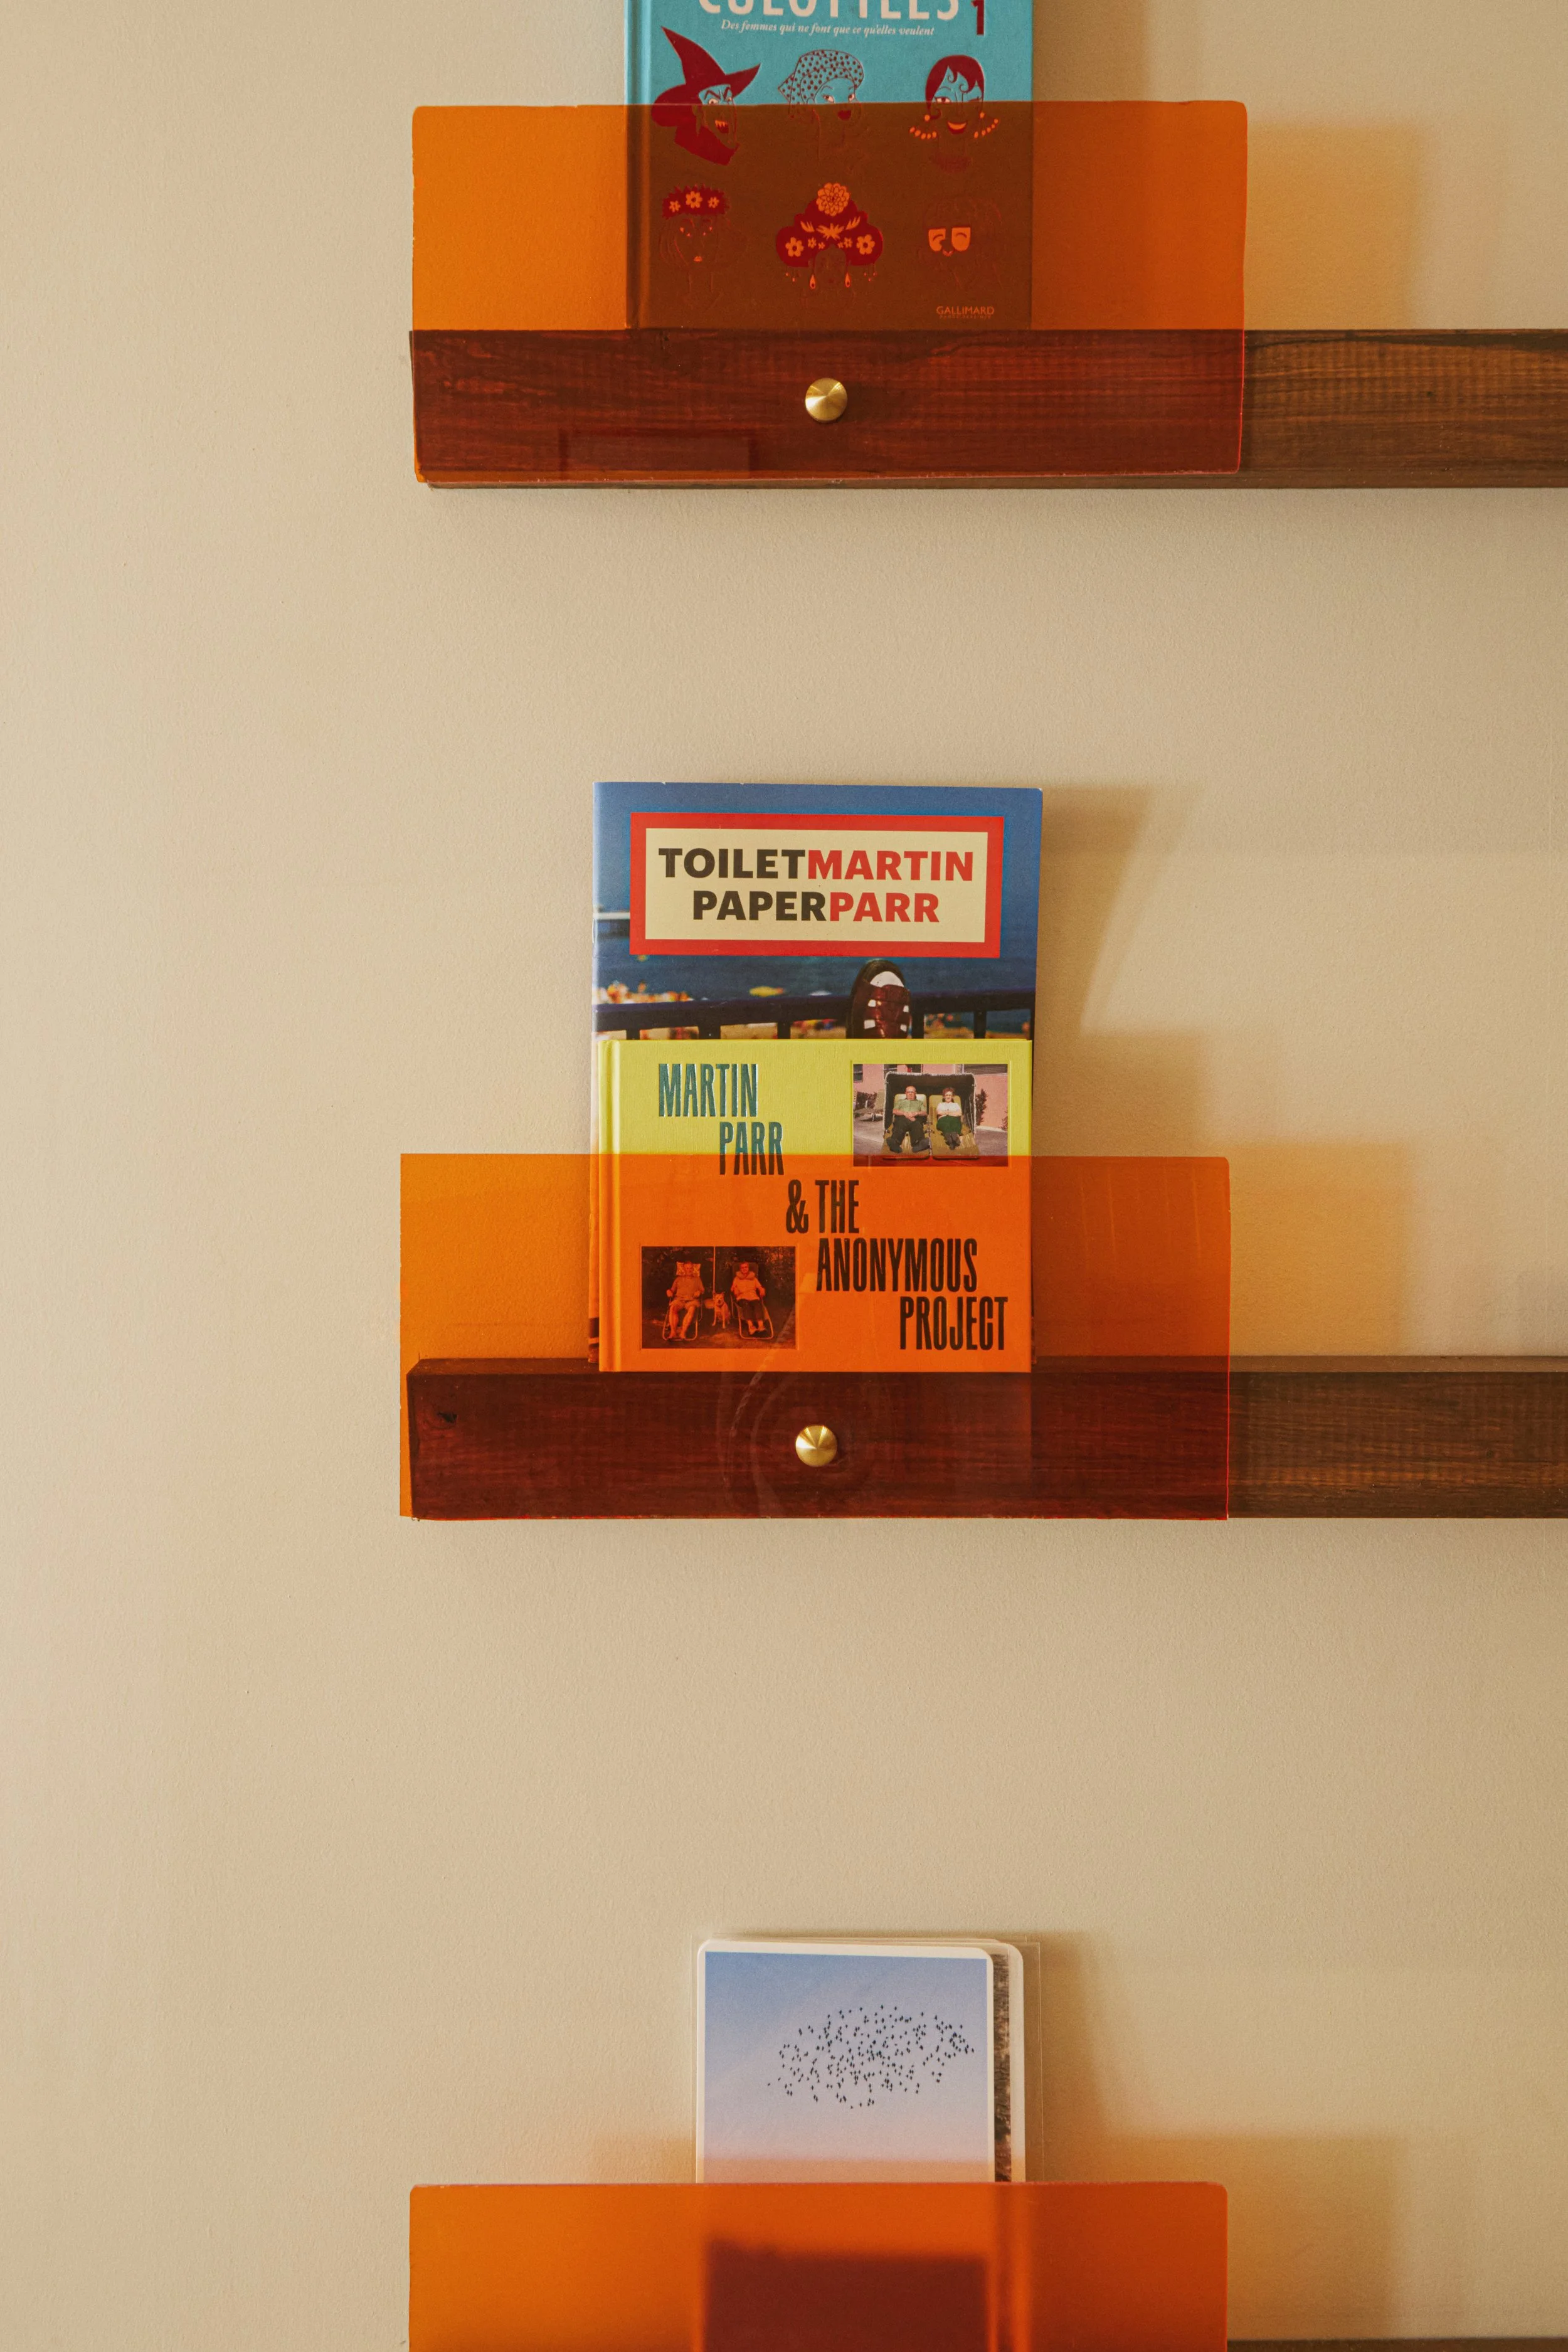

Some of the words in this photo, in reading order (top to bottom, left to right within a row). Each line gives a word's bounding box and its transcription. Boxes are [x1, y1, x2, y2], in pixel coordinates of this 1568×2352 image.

[721, 19, 739, 30] Des
[739, 20, 777, 33] femmes
[780, 23, 796, 35] qui
[798, 25, 810, 33] ne
[808, 23, 831, 36] font
[833, 26, 850, 37] que
[852, 26, 862, 34] ce
[863, 24, 896, 38] qu'elles
[898, 25, 935, 36] veulent
[936, 305, 995, 315] GALLIMARD
[659, 1063, 758, 1117] MARTIN
[719, 1121, 784, 1175] PARR
[785, 1179, 809, 1234] &
[815, 1180, 859, 1234] THE
[816, 1237, 977, 1293] ANONYMOUS
[899, 1296, 1009, 1350] PROJECT
